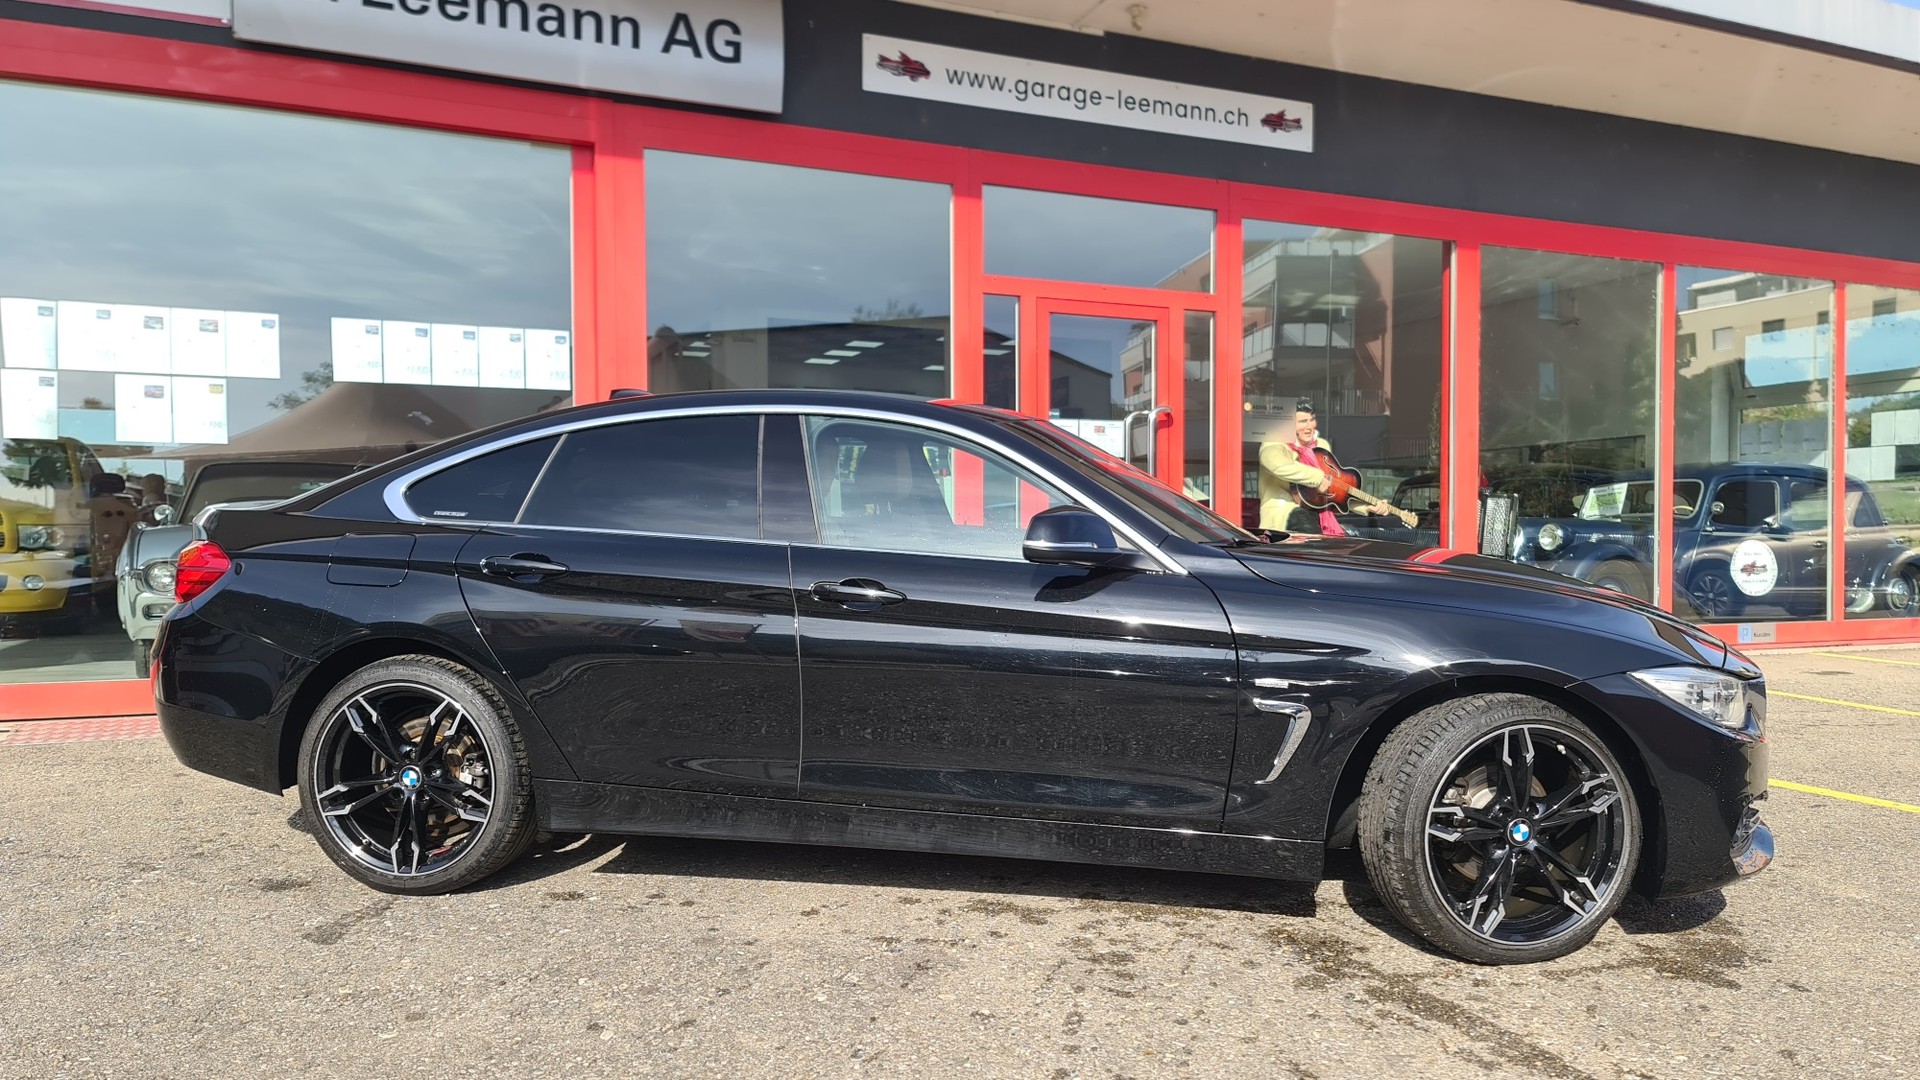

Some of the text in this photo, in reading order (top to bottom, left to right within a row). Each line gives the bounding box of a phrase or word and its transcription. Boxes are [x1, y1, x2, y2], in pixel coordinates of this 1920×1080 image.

[361, 0, 743, 64] eemann AG
[944, 67, 1249, 127] www.garage-leemann.ch
